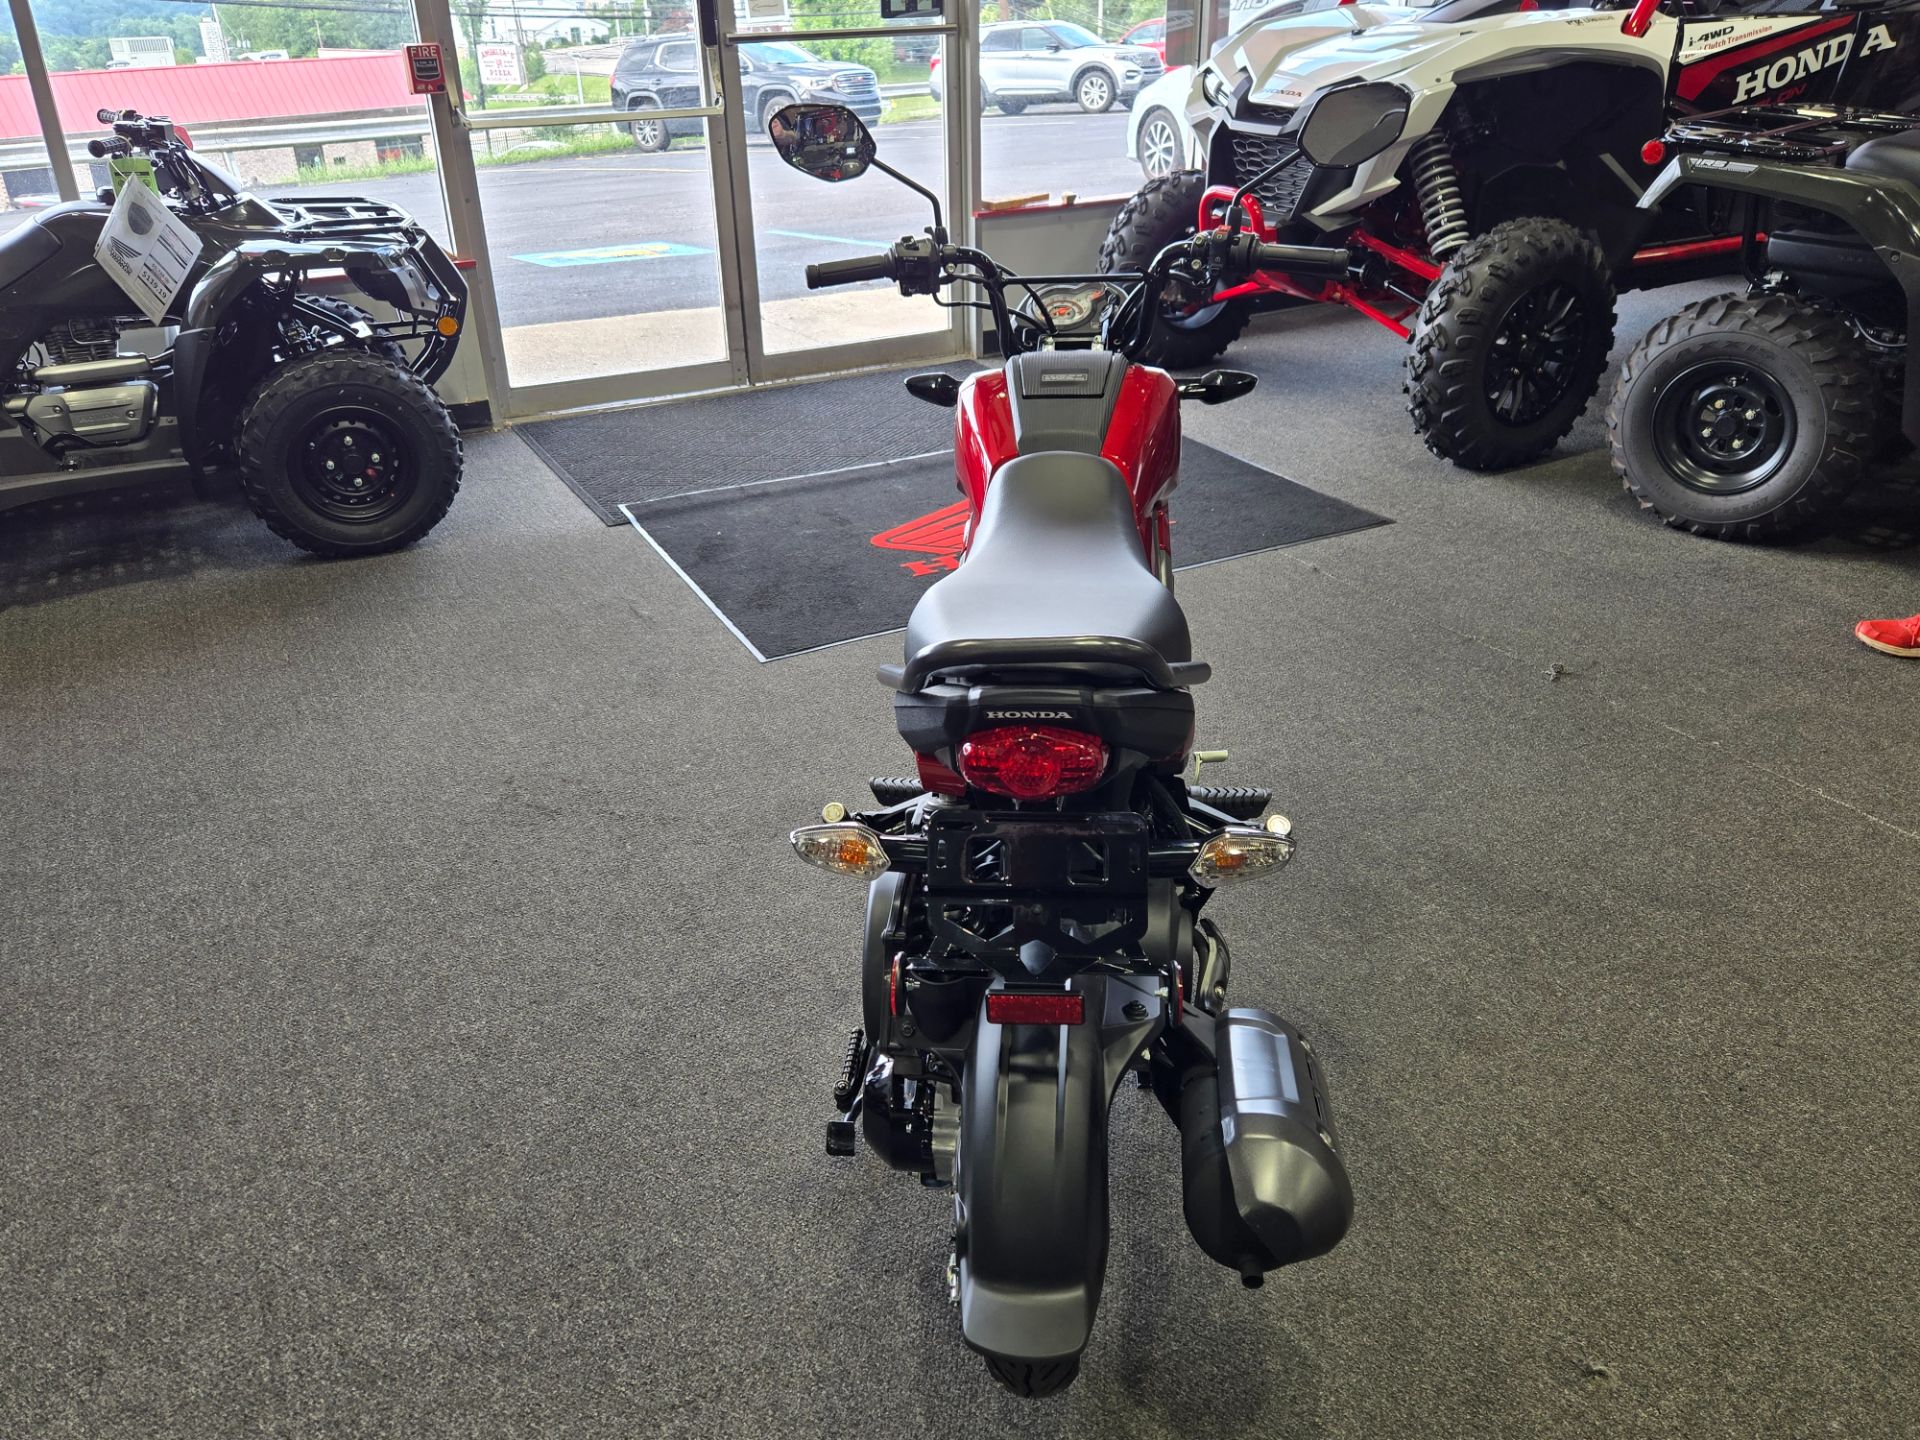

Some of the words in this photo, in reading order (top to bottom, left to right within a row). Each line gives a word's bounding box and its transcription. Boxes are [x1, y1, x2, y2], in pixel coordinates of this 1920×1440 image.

[1688, 25, 1735, 47] i-4WD
[1703, 39, 1726, 50] Clutch
[1727, 25, 1773, 44] Transmission
[410, 46, 438, 57] FIRE
[1732, 24, 1897, 105] HONDA
[985, 711, 1073, 719] HONDA
